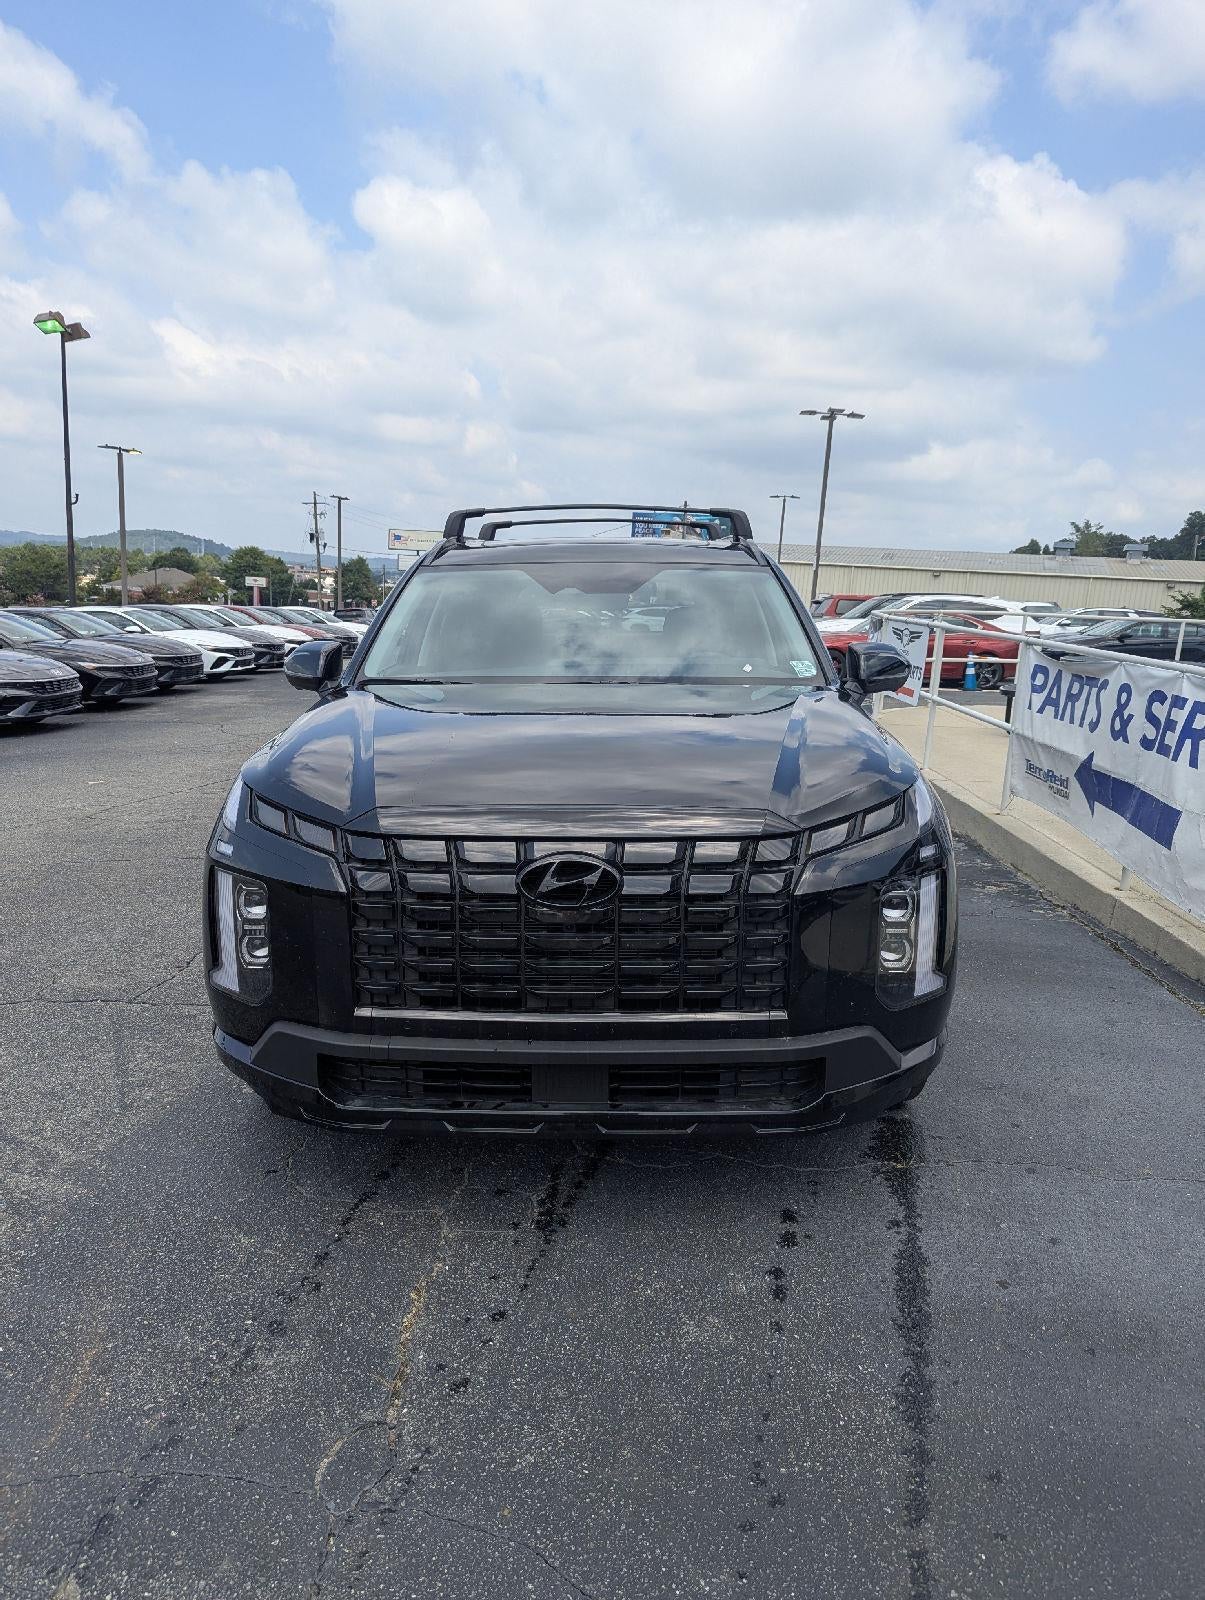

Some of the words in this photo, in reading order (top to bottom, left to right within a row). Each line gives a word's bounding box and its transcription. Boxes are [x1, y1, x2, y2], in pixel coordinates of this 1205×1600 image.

[1027, 663, 1109, 733] PARTS
[1110, 682, 1135, 744] &
[1139, 689, 1205, 770] SER
